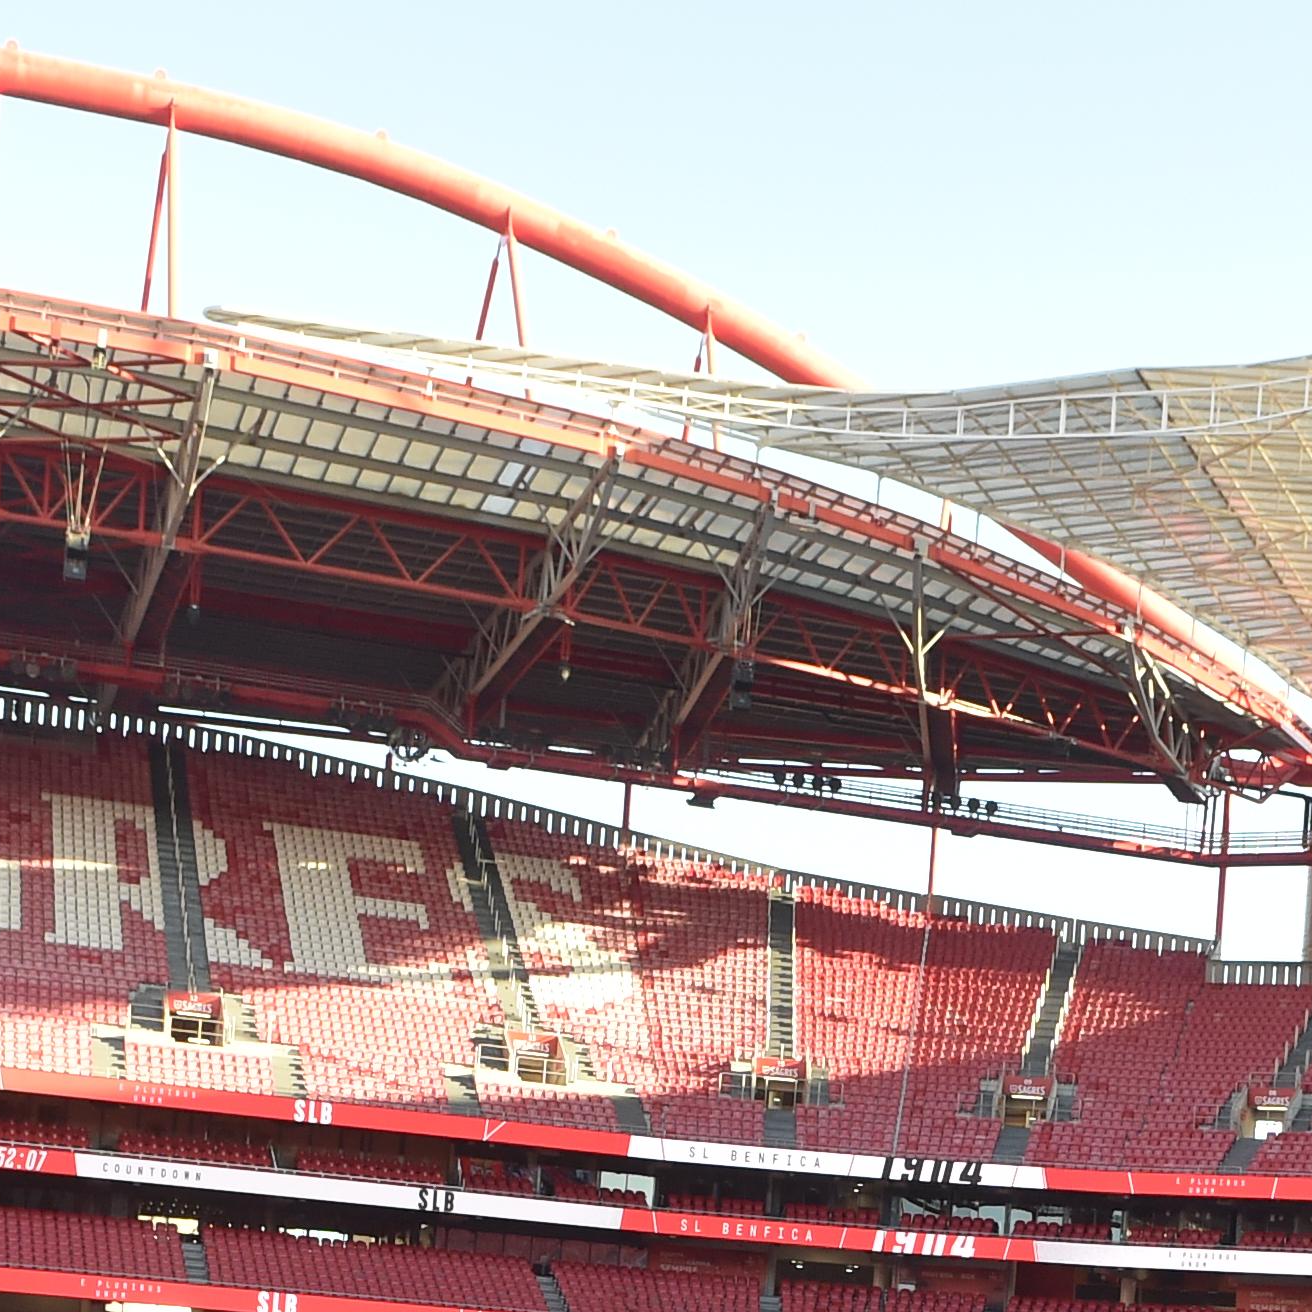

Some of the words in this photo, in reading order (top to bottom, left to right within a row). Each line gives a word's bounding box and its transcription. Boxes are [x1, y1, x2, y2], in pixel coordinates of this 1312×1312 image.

[1017, 1084, 1045, 1095] SAGRES
[293, 1099, 333, 1125] SLB
[689, 1146, 709, 1160] SL
[731, 1149, 821, 1169] BENFICA
[102, 1162, 202, 1182] COUNTDOWN
[418, 1188, 455, 1212] SLB
[680, 1219, 702, 1233] SL
[722, 1222, 813, 1242] BENFICA
[872, 1229, 976, 1259] 1904
